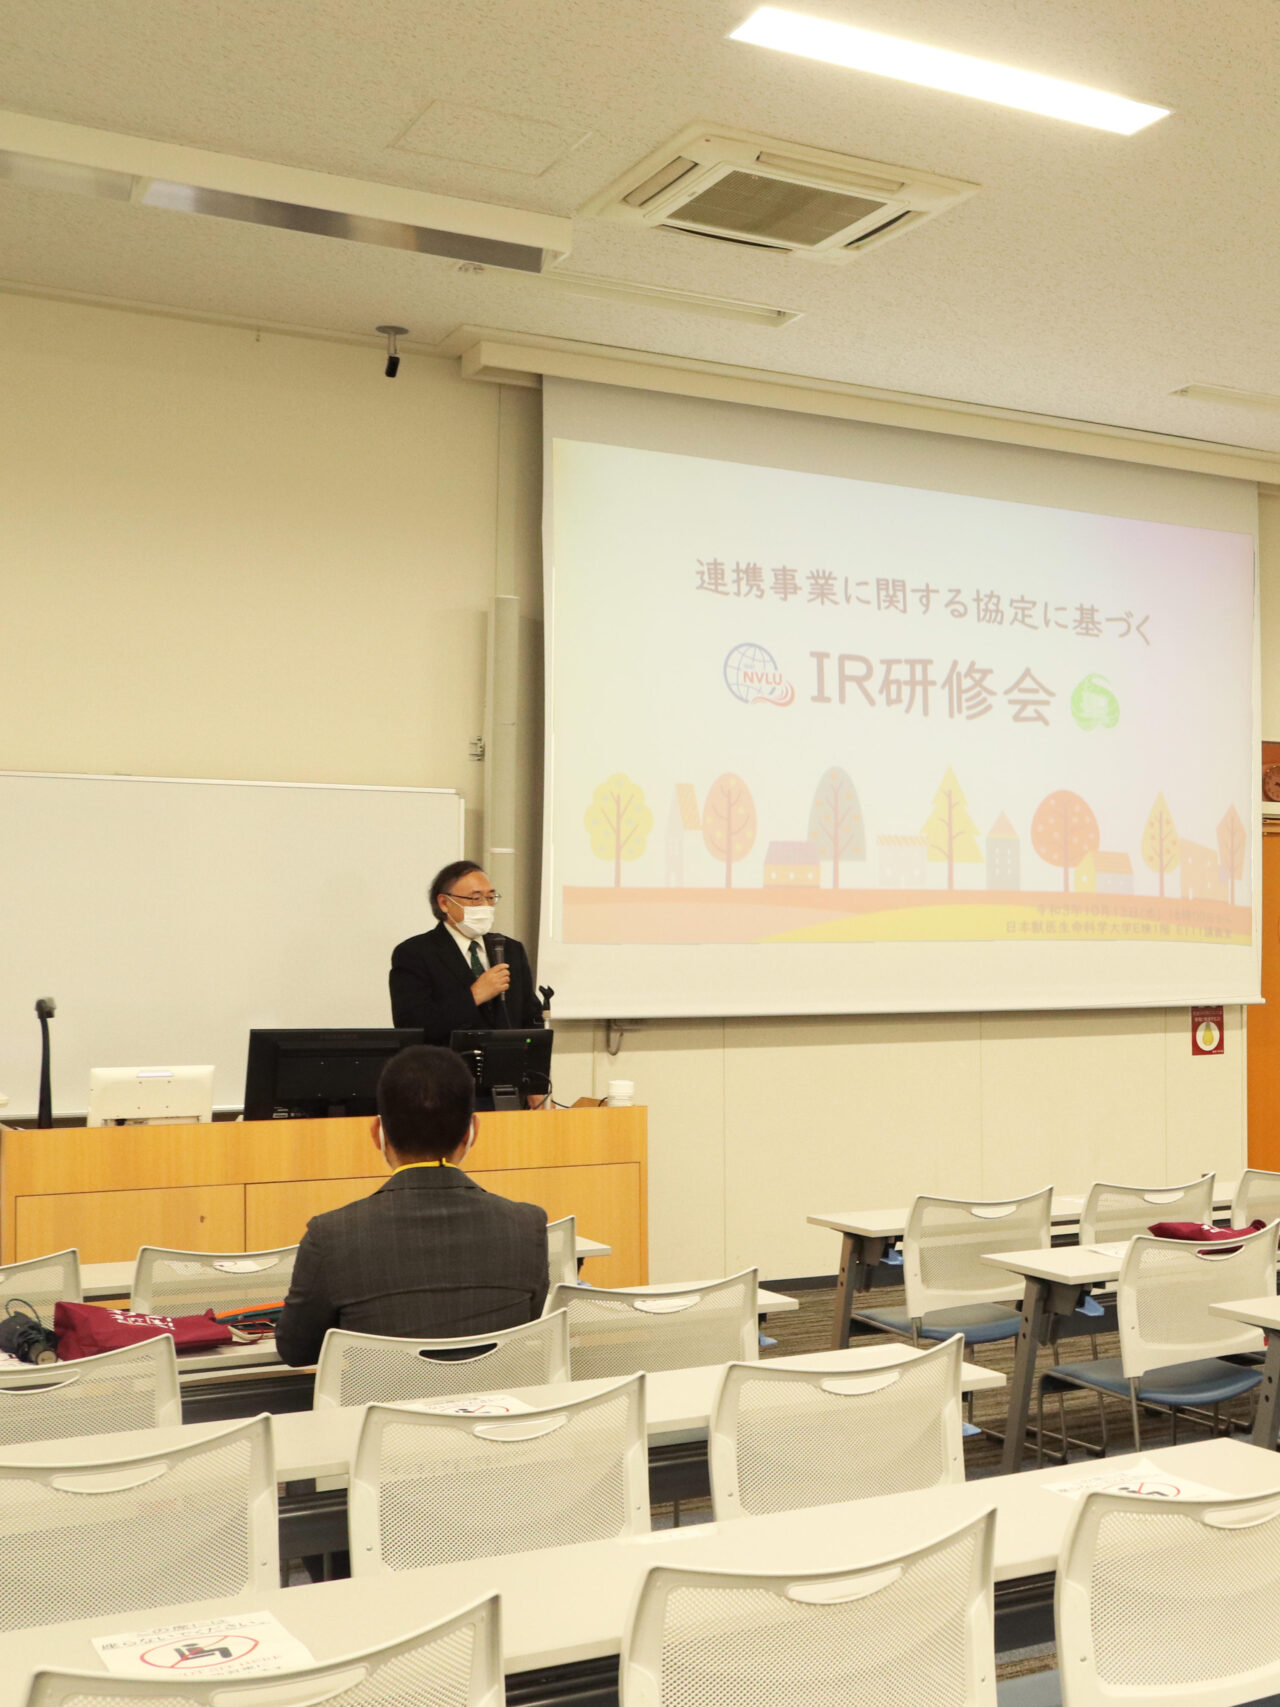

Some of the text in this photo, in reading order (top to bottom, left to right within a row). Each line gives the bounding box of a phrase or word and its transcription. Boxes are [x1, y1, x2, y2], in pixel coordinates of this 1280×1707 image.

[694, 557, 1152, 646] 連携事業に関する協定に基づく
[743, 670, 783, 686] NVLU
[809, 650, 1057, 727] IR研修会
